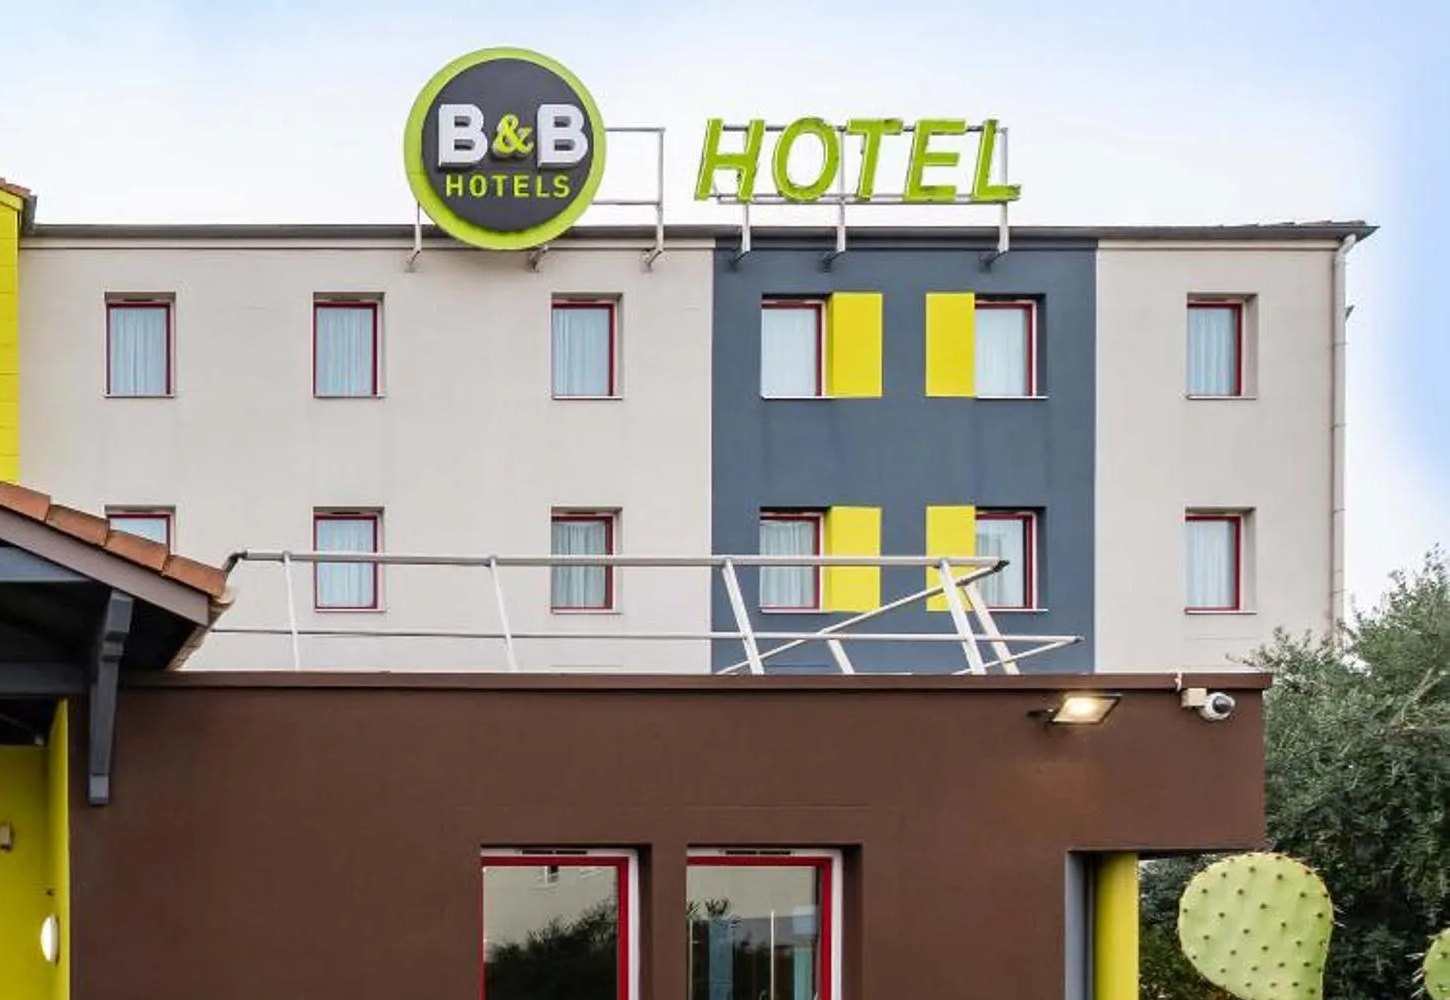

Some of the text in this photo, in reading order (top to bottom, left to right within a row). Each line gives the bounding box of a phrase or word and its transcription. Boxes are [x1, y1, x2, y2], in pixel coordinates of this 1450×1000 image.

[438, 103, 589, 168] B&B
[694, 116, 1022, 203] HOTEL
[445, 173, 572, 199] HOTELS
